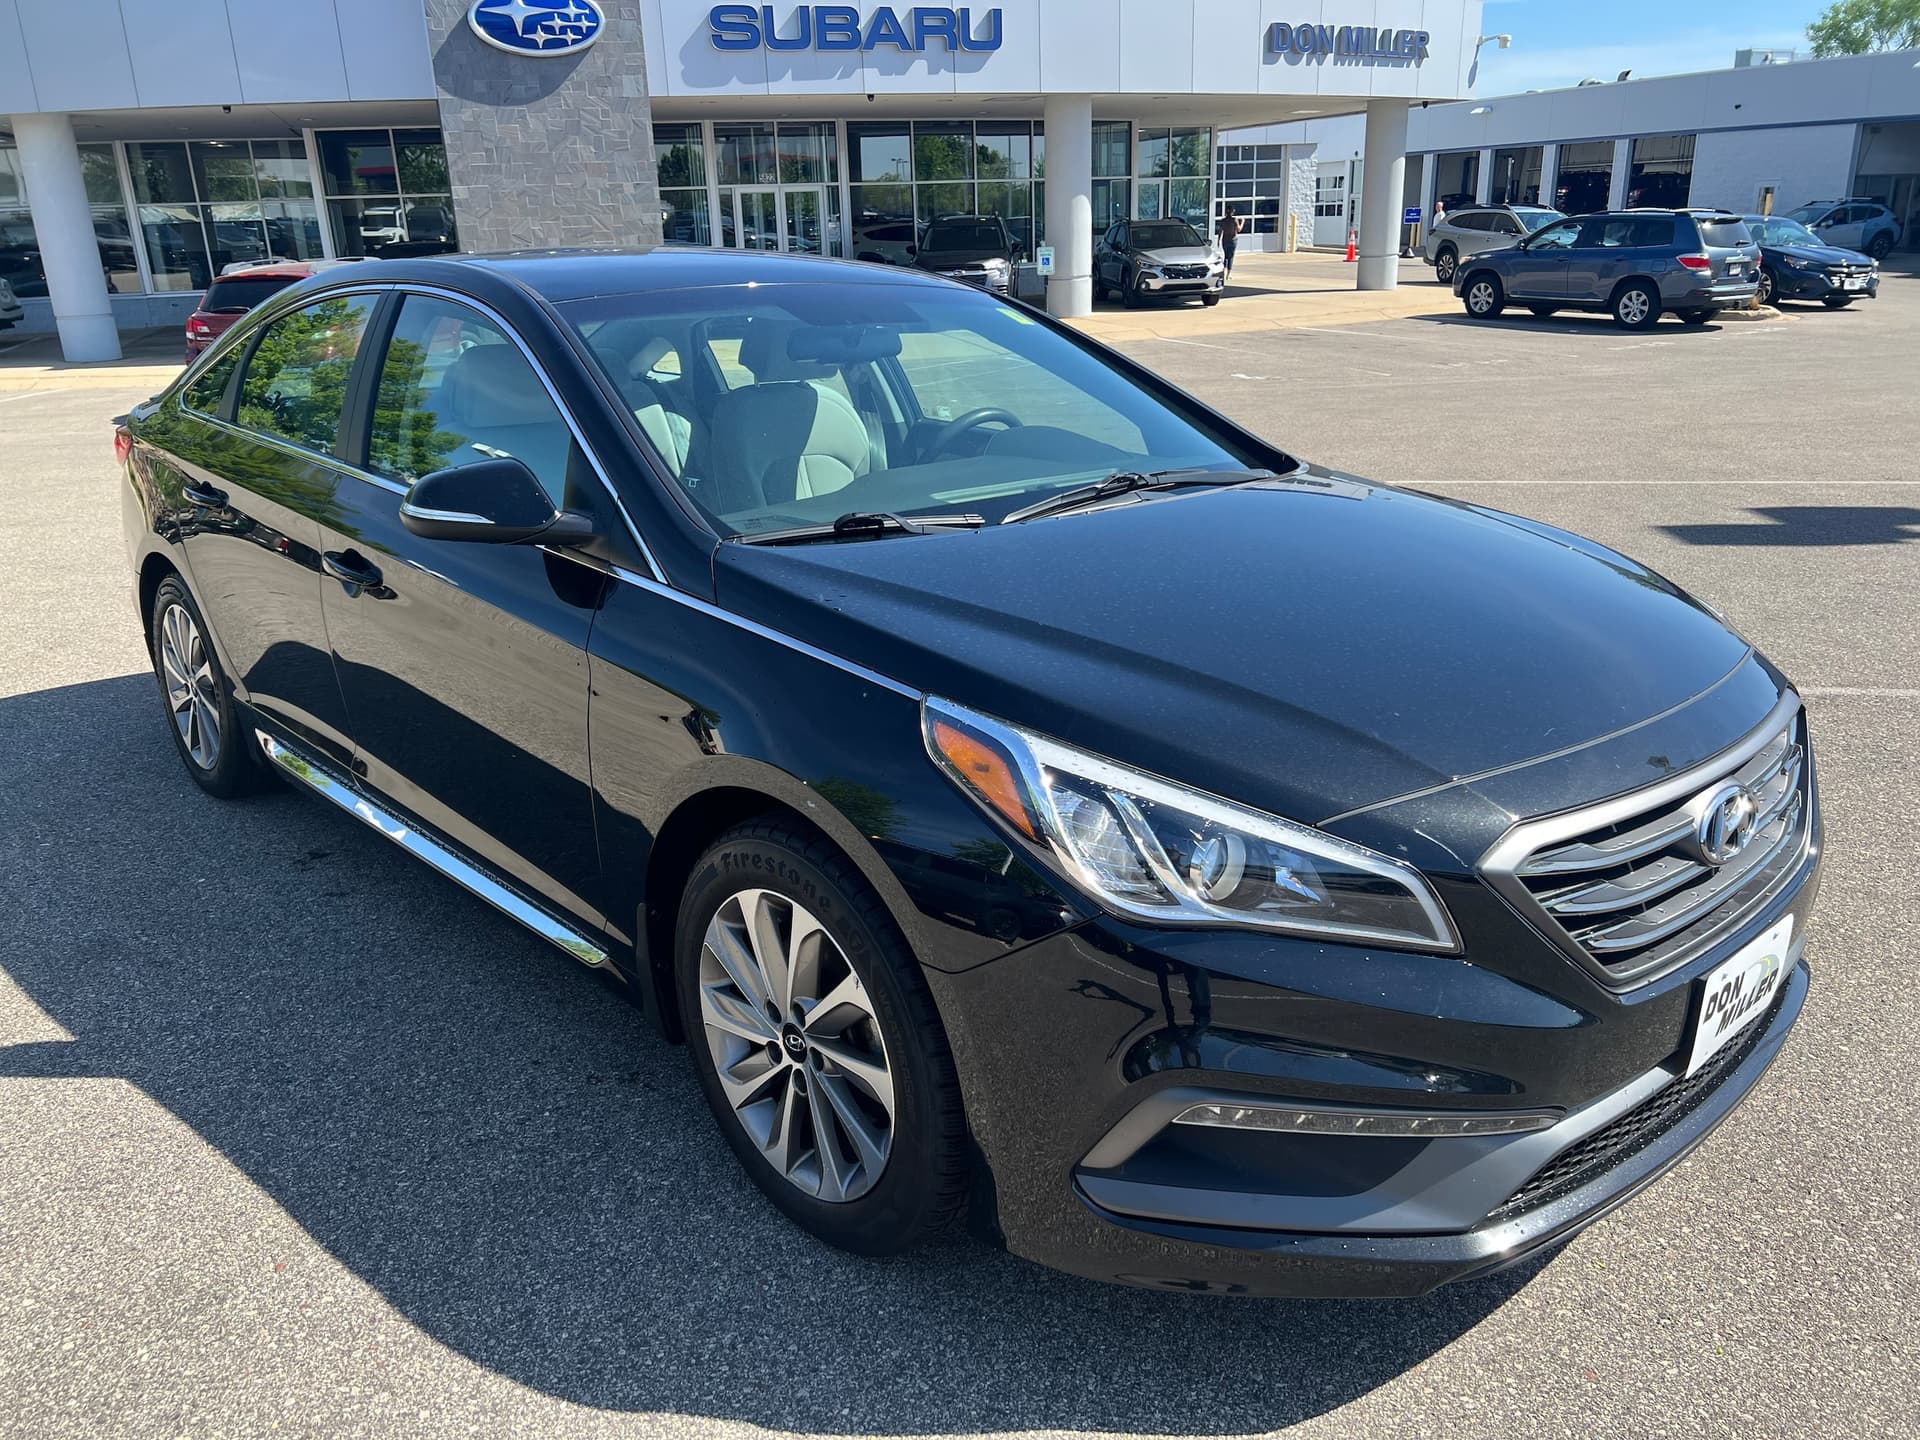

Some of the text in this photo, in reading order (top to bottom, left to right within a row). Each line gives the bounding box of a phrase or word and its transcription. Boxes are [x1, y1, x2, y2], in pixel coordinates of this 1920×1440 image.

[709, 4, 1003, 51] SUBARU
[1266, 22, 1429, 58] DON MILLER
[720, 850, 832, 913] Firestone
[1702, 970, 1746, 1024] DON
[1714, 967, 1779, 1036] MILLER
